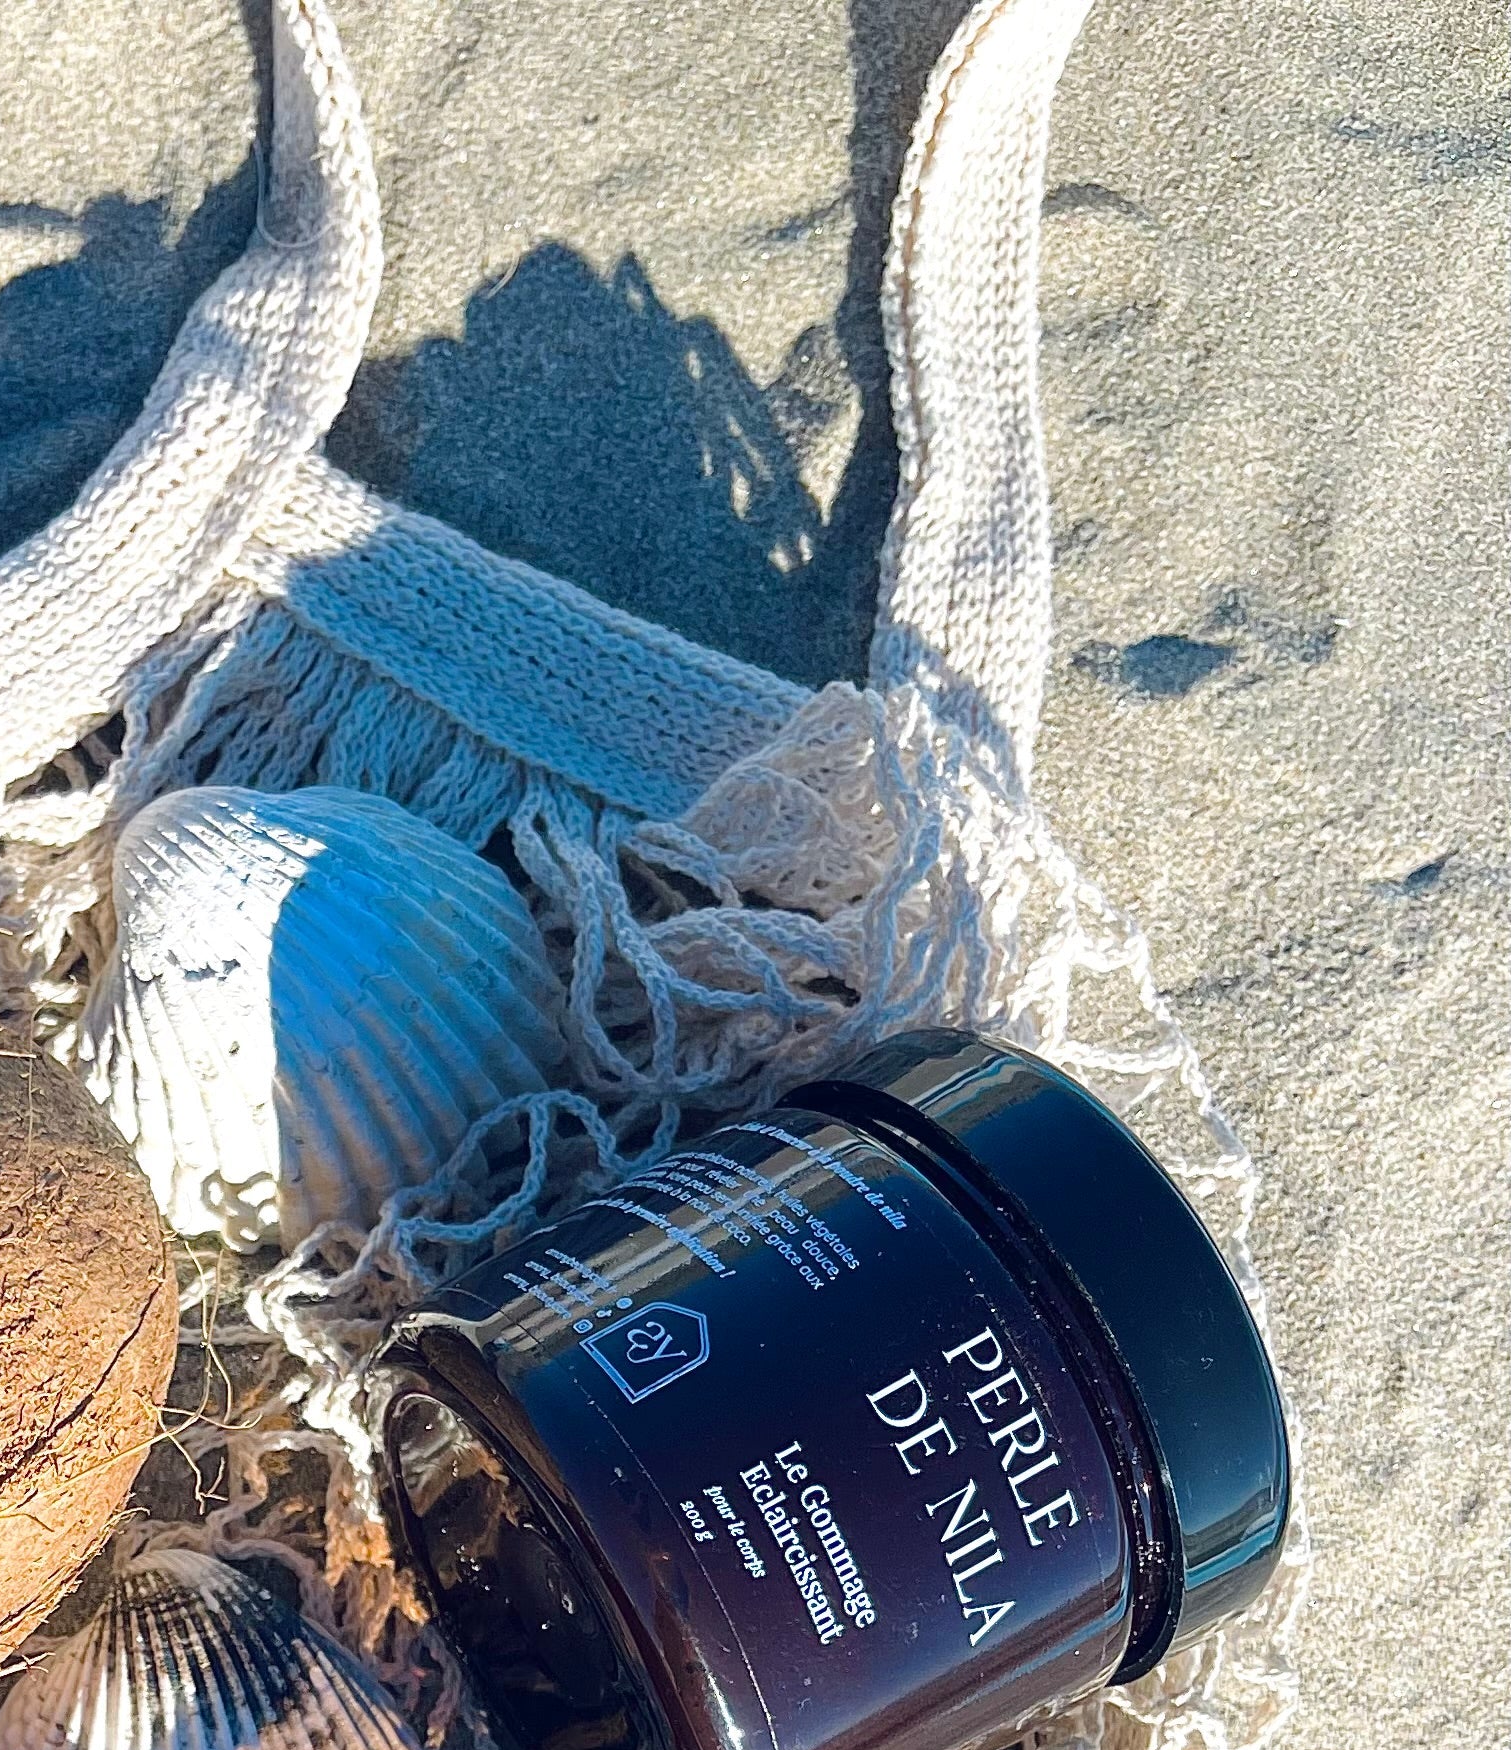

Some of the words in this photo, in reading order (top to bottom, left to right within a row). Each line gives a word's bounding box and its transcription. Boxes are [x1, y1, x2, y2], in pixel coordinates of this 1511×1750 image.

[823, 1161, 870, 1194] poudre
[865, 1191, 885, 1207] de
[879, 1205, 907, 1230] nila
[723, 1221, 751, 1247] coco.
[768, 1209, 800, 1235] peau
[802, 1240, 839, 1280] douce,
[773, 1189, 808, 1217] huiles
[806, 1215, 860, 1270] végétales
[719, 1269, 736, 1278] !
[765, 1234, 802, 1266] grâce
[799, 1266, 825, 1290] aux
[941, 1326, 1081, 1547] PERLE
[680, 1501, 706, 1529] 200
[694, 1530, 715, 1542] g
[703, 1486, 736, 1521] pour
[727, 1520, 746, 1538] le
[775, 1440, 808, 1484] Le
[800, 1485, 876, 1629] Gommage
[866, 1368, 959, 1475] DE
[925, 1479, 1016, 1647] NILA
[736, 1537, 766, 1578] corps
[740, 1461, 845, 1645] Eclaircissant
